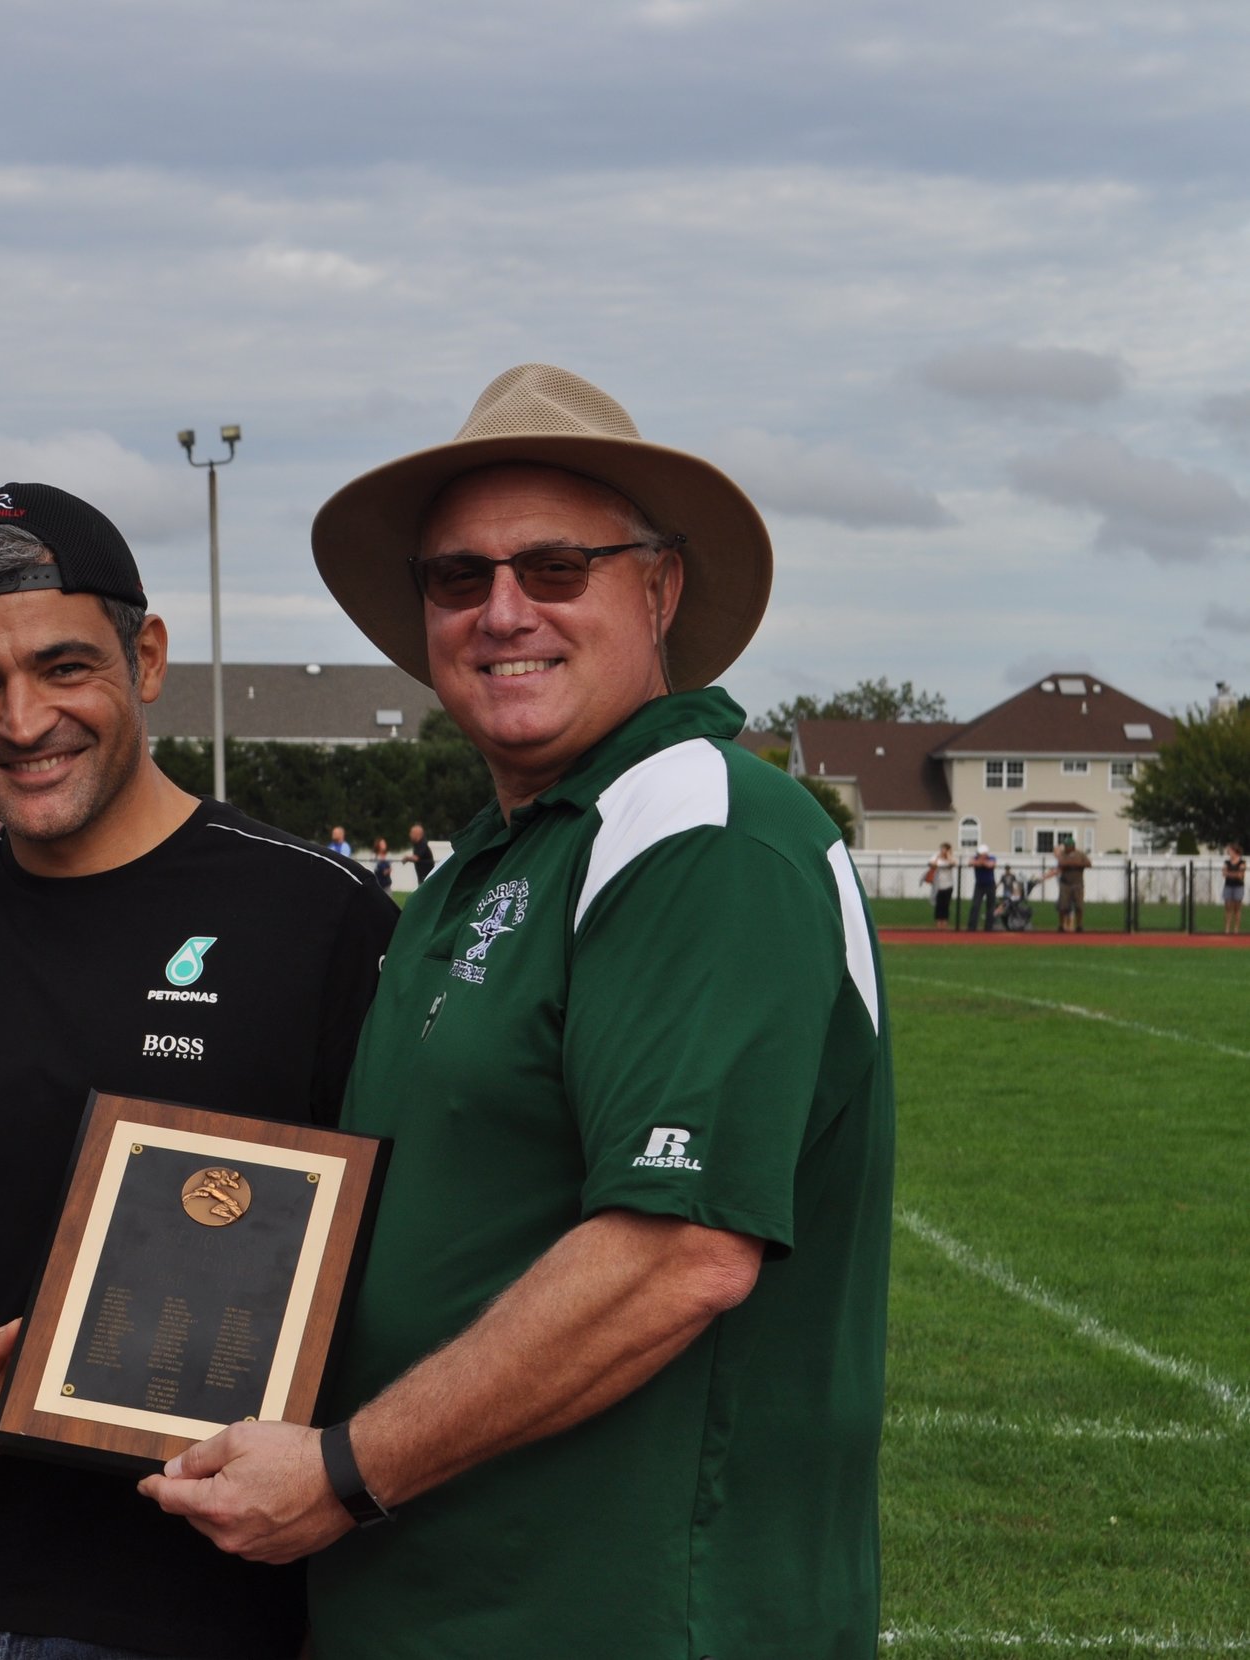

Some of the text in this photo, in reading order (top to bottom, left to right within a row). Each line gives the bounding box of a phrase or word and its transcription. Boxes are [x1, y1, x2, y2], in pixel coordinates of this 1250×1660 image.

[147, 990, 218, 1003] PETRONAS
[143, 1034, 204, 1054] BOSS
[632, 1156, 703, 1171] RUSSELL
